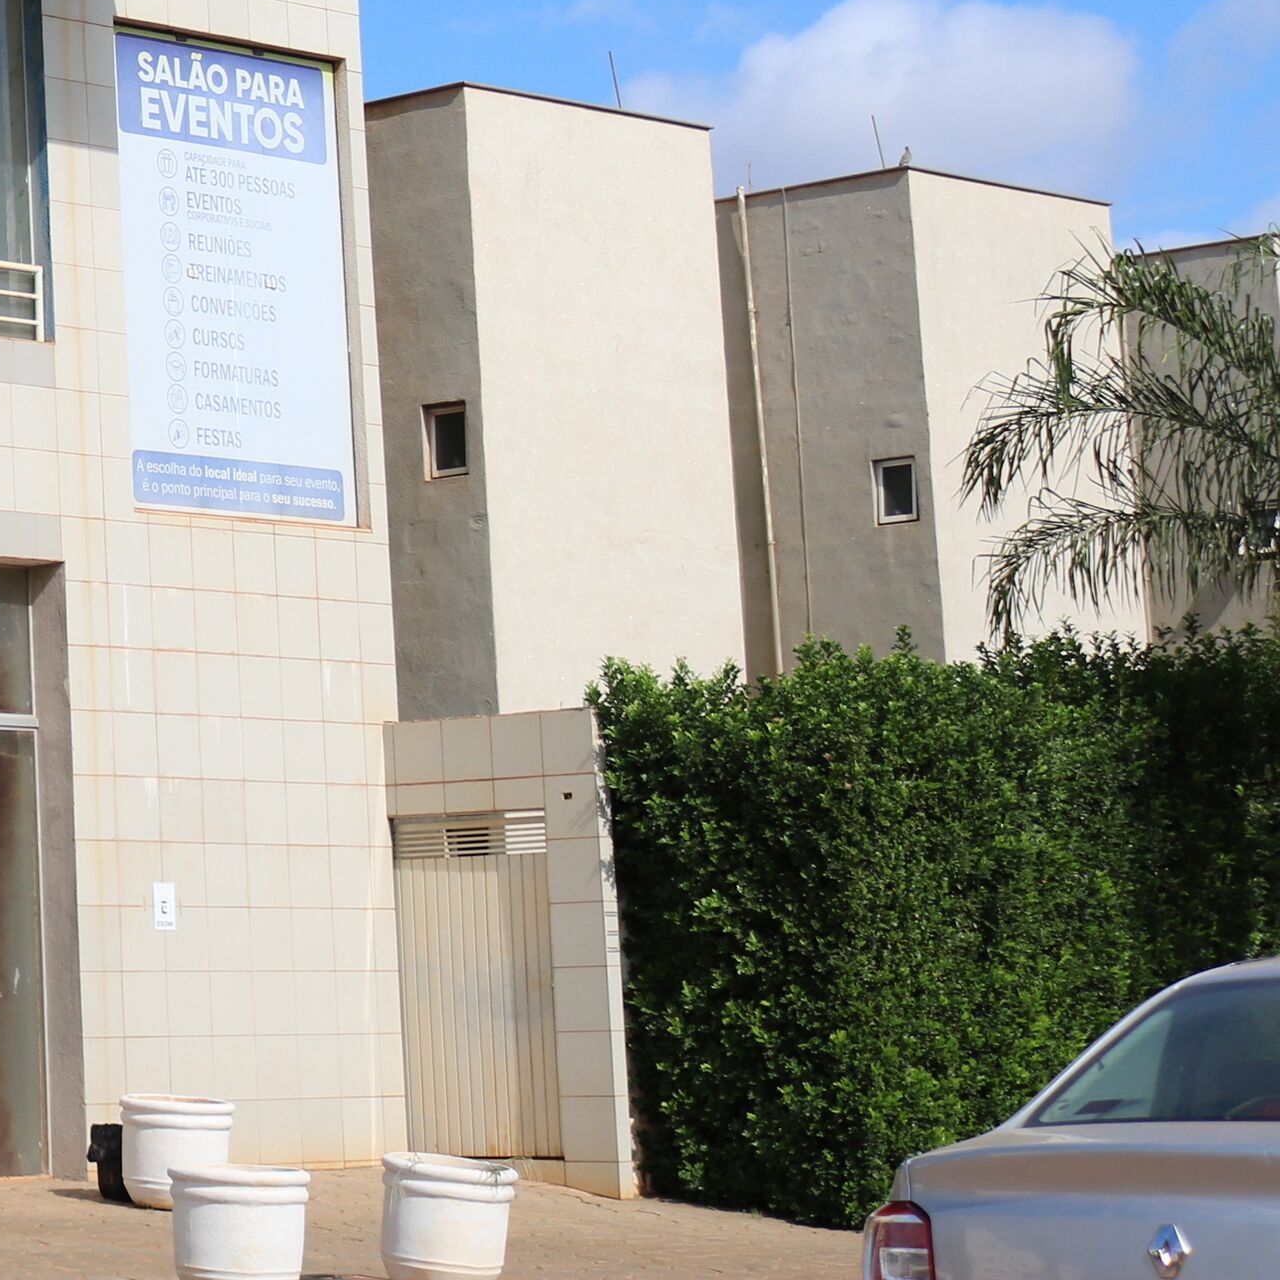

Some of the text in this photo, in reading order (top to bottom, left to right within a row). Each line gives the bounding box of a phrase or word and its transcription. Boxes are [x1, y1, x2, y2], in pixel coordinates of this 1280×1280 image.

[137, 51, 305, 109] SALÃO PARA
[141, 86, 305, 154] EVENTOS
[210, 169, 234, 189] 300
[238, 174, 296, 199] PESSOAS
[186, 191, 242, 215] EVENTOS
[188, 232, 252, 258] REUNIÕES
[188, 263, 287, 293] TREINAMENTOS
[191, 295, 277, 323] CONVENÇÕES
[192, 328, 245, 351] CURSOS
[193, 360, 280, 387] FORMATURAS
[195, 392, 282, 420] CASAMENTOS
[196, 427, 243, 449] FESTAS
[136, 458, 145, 472] A
[146, 462, 187, 476] escolha
[189, 463, 202, 477] do
[204, 465, 231, 481] local
[233, 467, 257, 483] ideal
[259, 472, 282, 486] para
[284, 475, 302, 488] seu
[142, 478, 337, 510] é o ponto principal para o seu sucesso.
